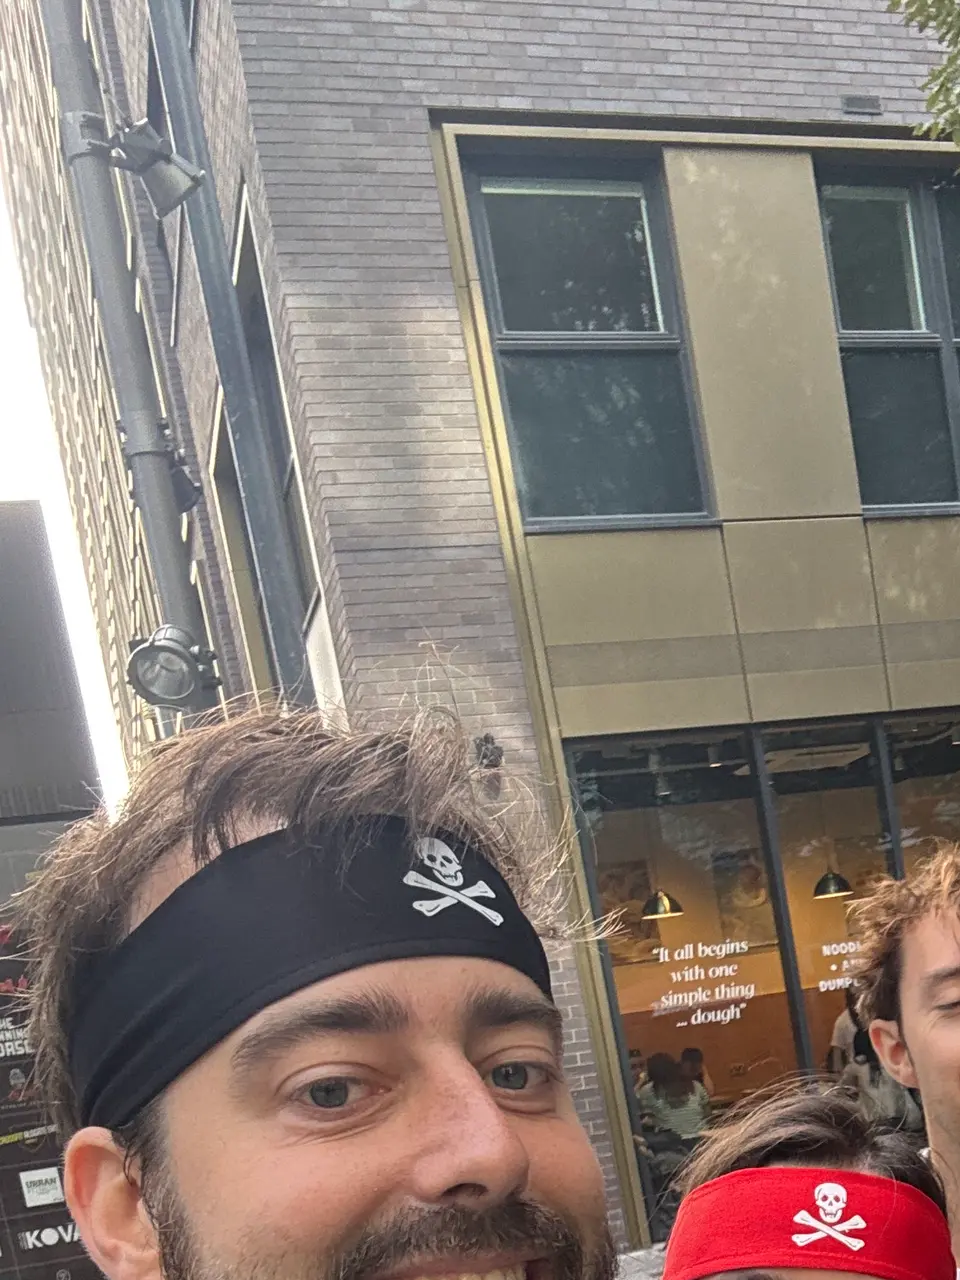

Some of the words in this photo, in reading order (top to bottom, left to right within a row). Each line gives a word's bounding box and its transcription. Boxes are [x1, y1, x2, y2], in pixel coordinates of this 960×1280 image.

[674, 943, 694, 961] all
[697, 938, 749, 960] begins
[822, 941, 862, 957] NOODL
[670, 964, 706, 984] with
[708, 963, 738, 979] one
[660, 986, 712, 1007] simple
[714, 981, 756, 1000] thing
[818, 977, 861, 993] DUMPL
